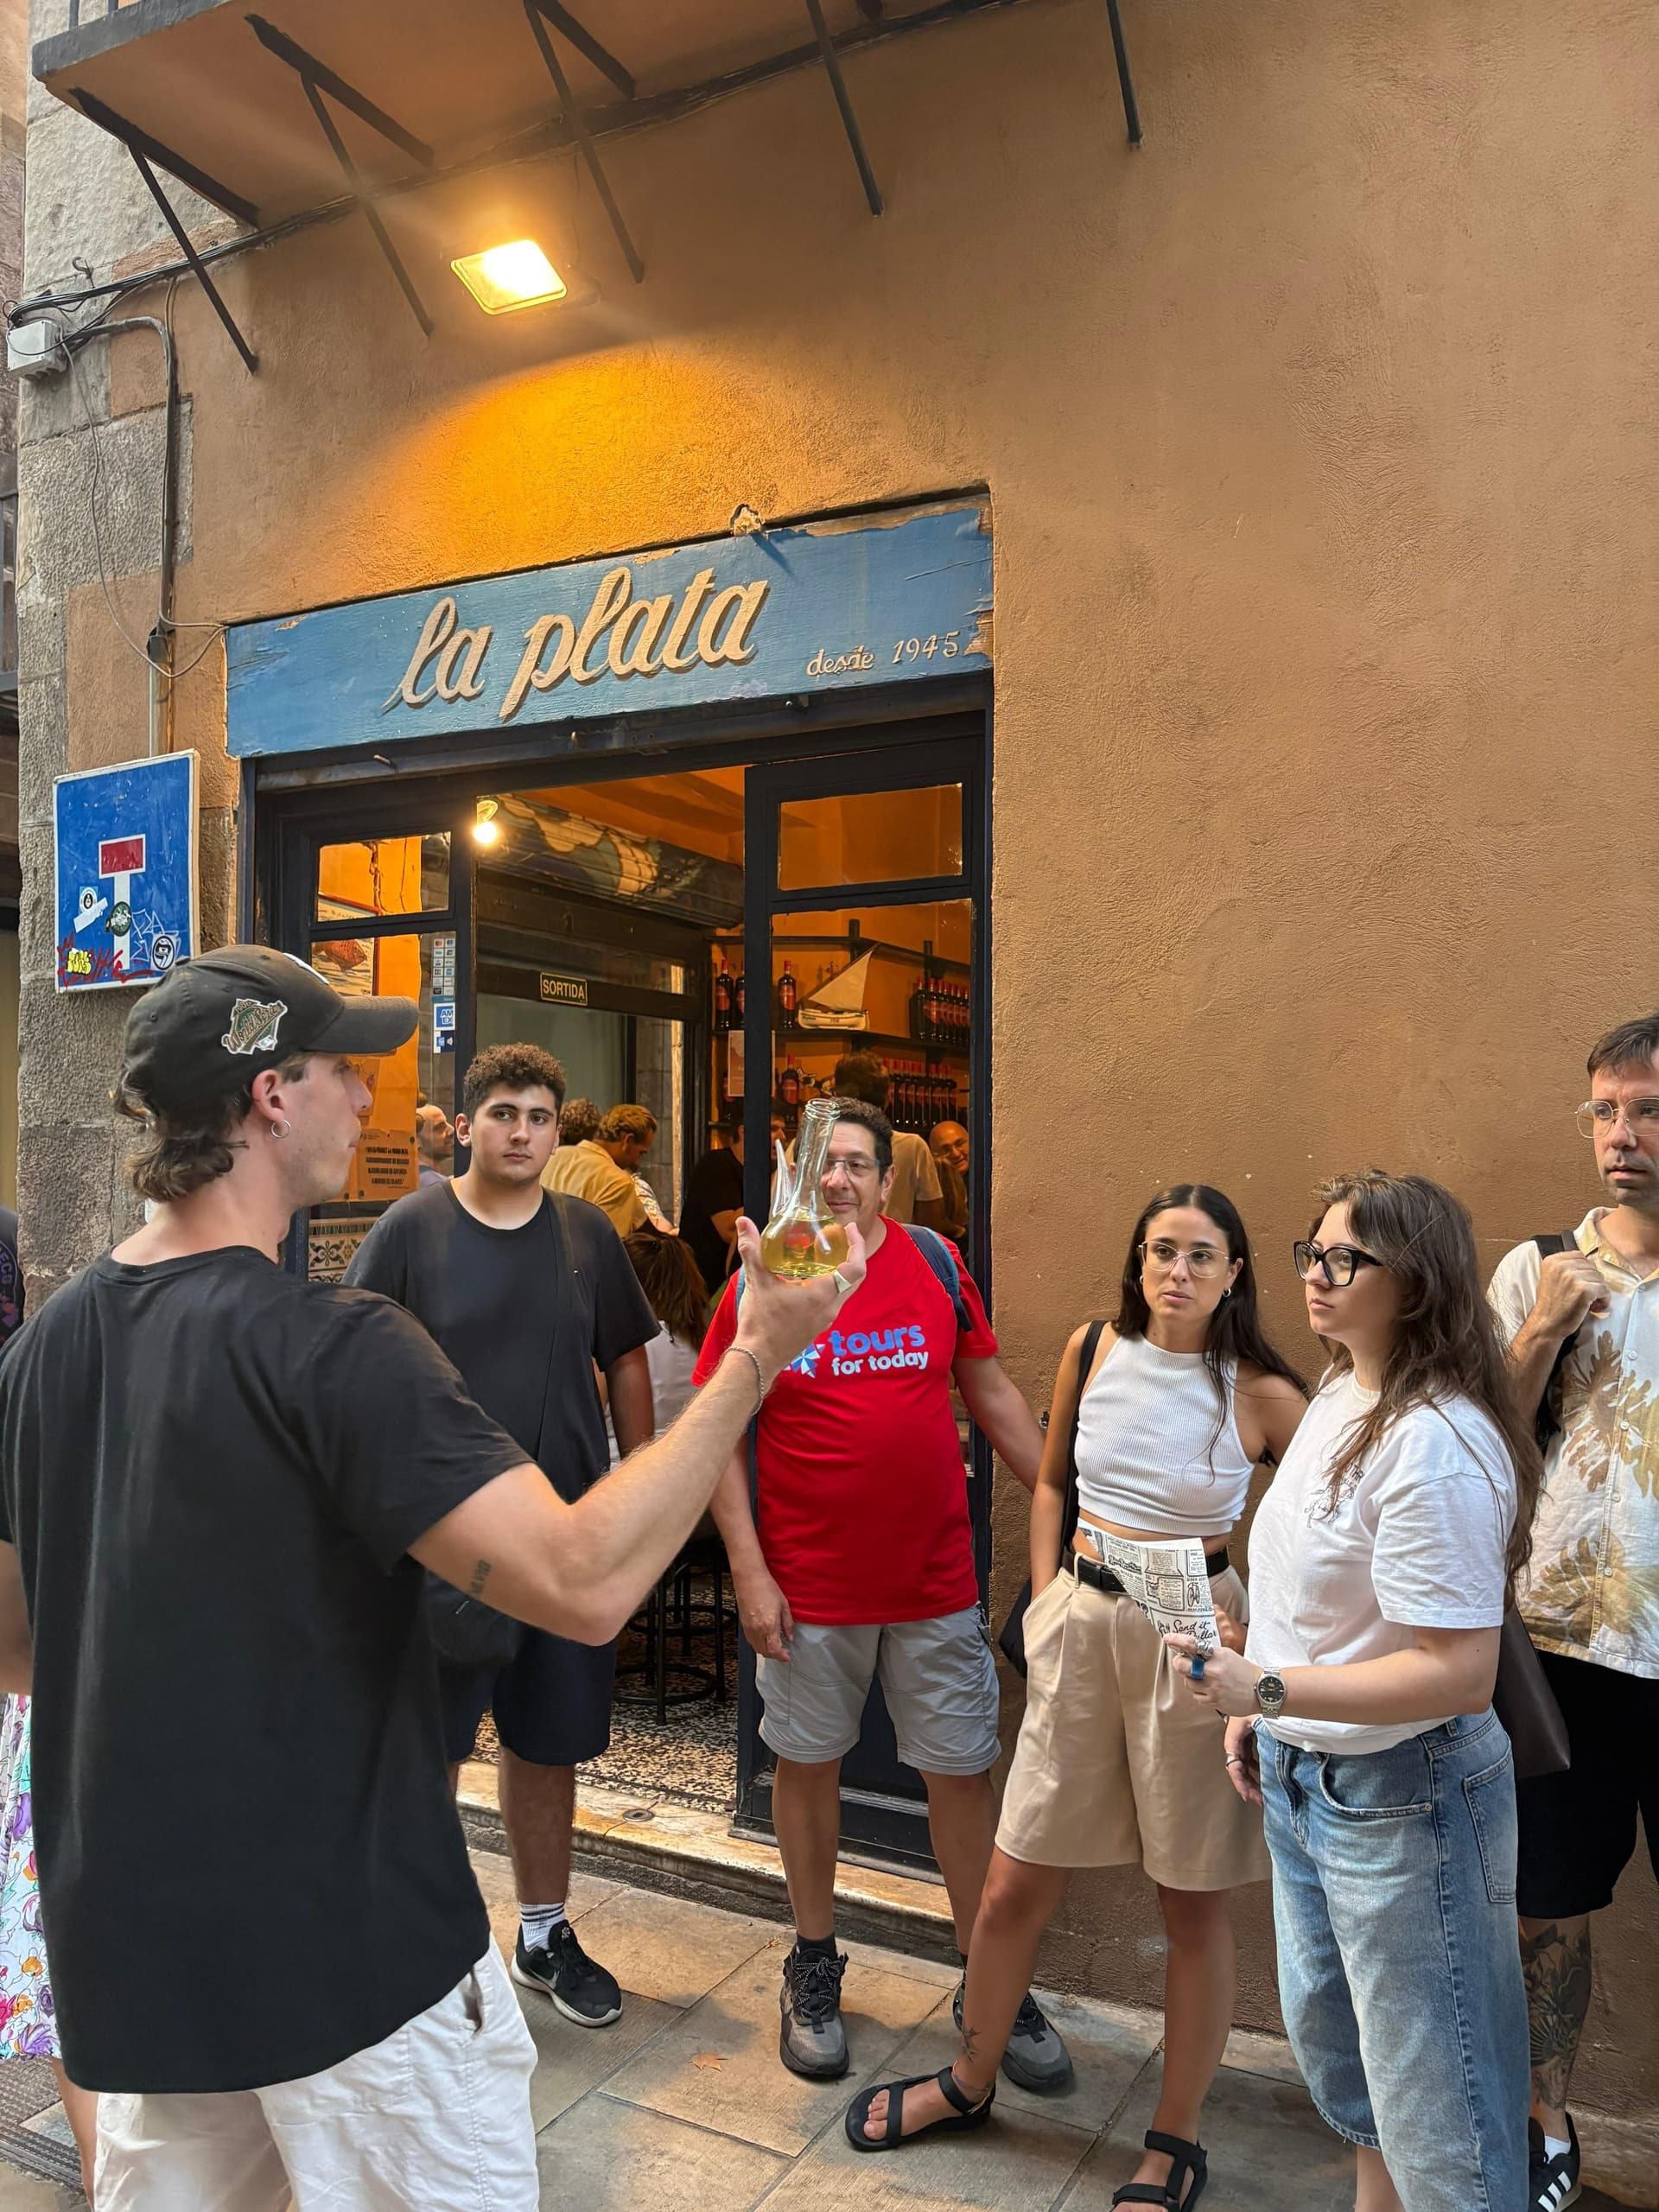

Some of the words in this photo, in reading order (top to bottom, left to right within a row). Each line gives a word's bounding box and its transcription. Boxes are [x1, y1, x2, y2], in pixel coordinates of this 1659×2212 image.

[381, 597, 493, 709] la
[499, 567, 769, 720] plata
[806, 645, 875, 677] desde
[892, 630, 961, 664] 1945
[543, 979, 585, 1000] SORTIDA
[828, 1325, 926, 1356] tours
[831, 1357, 863, 1376] for
[868, 1349, 929, 1370] today
[1173, 1619, 1198, 1633] Send
[1198, 1621, 1211, 1630] it
